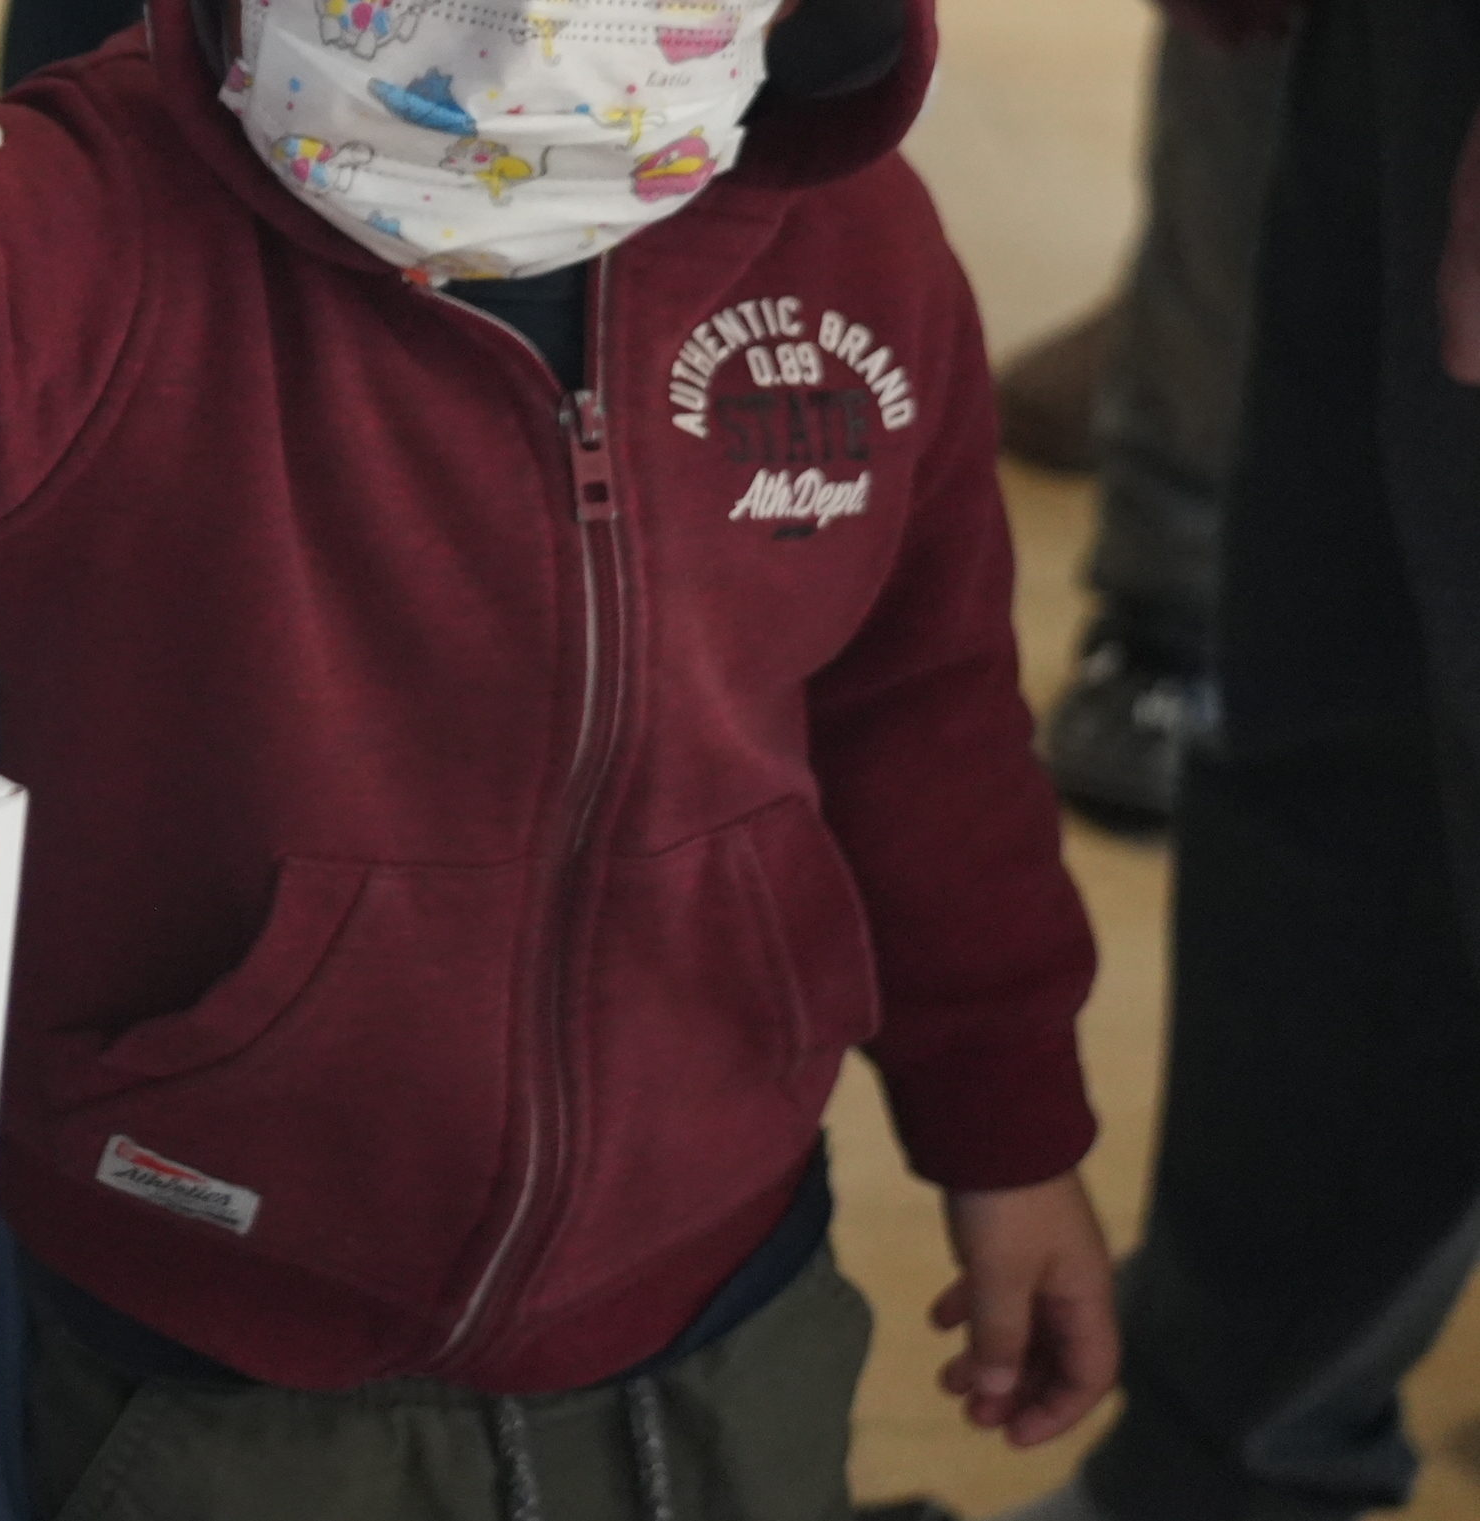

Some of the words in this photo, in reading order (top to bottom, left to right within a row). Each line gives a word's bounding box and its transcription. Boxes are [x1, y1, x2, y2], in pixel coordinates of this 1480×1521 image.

[669, 295, 805, 440] AUTHENTIC
[817, 308, 917, 432] BRAND
[744, 340, 825, 387] 0.89
